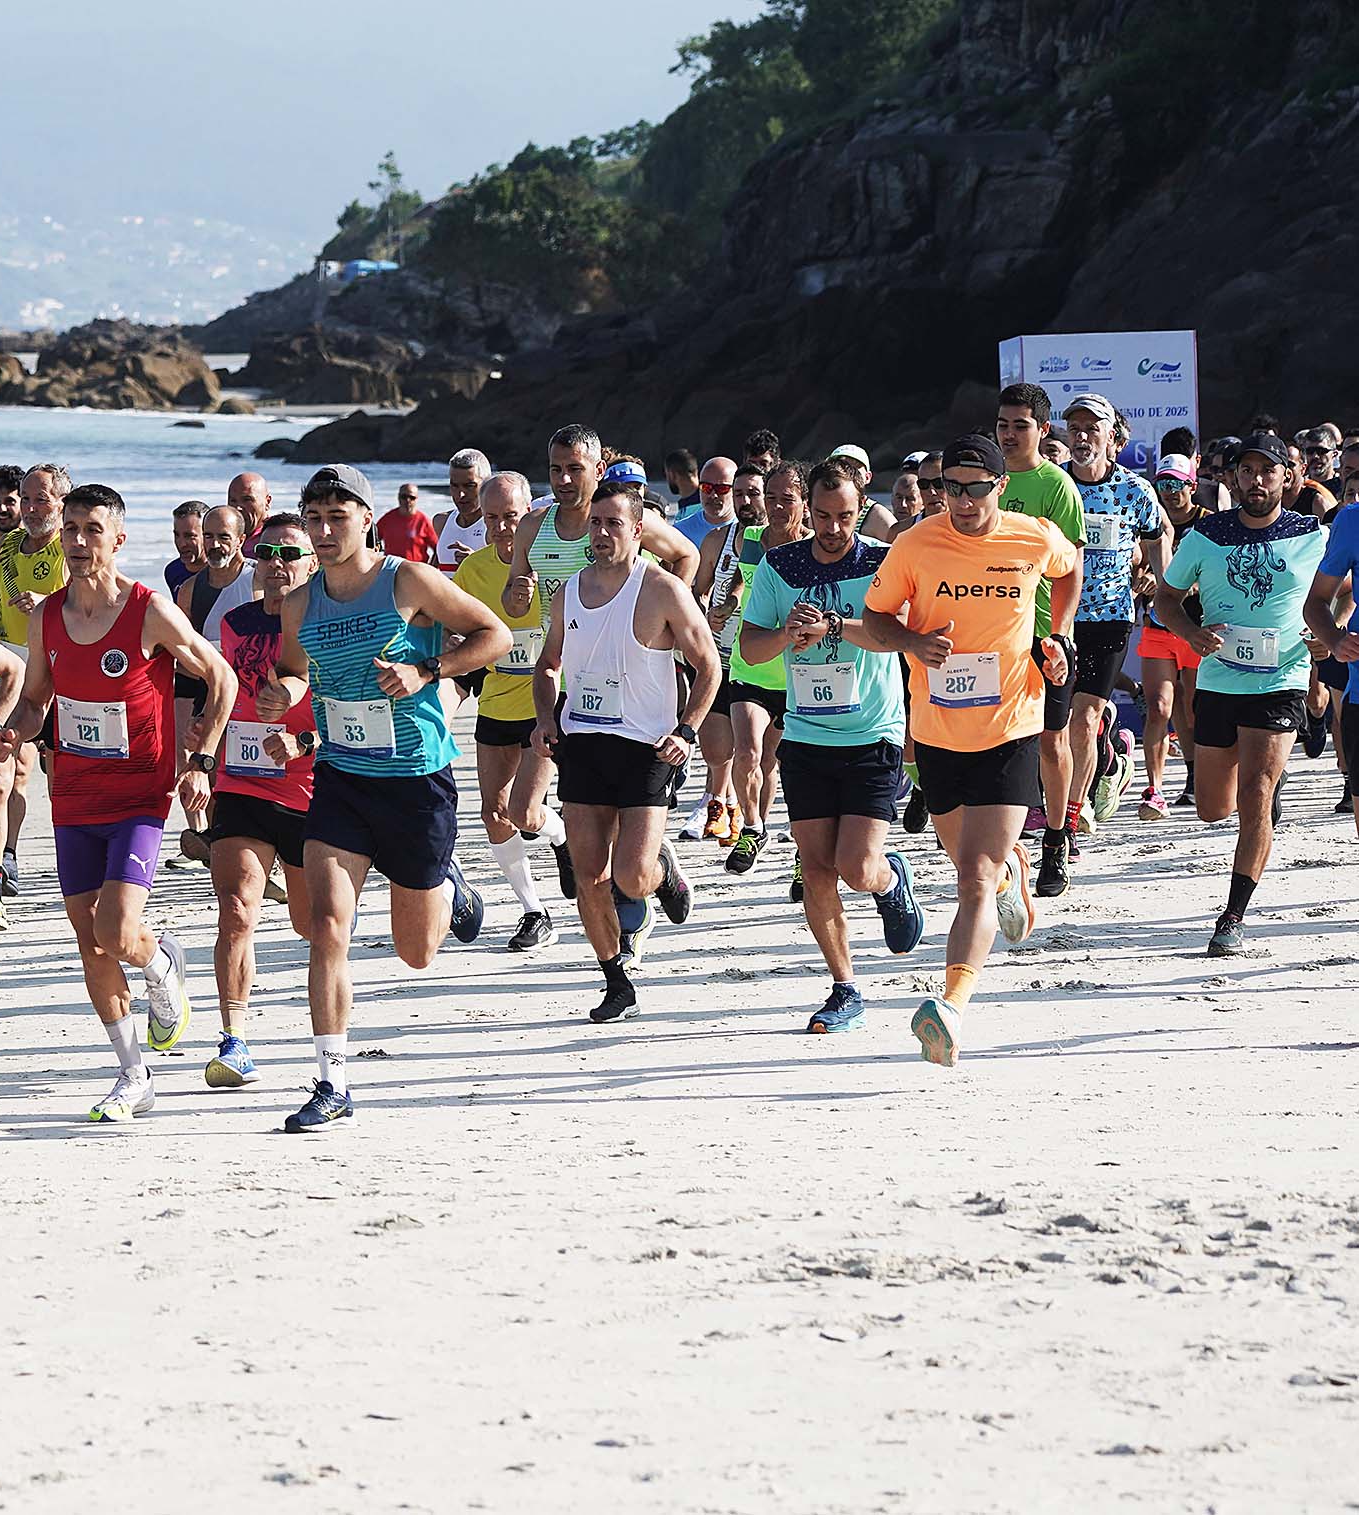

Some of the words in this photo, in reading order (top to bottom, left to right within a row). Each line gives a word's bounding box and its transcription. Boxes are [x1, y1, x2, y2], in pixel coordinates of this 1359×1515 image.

[1149, 407, 1163, 417] DE
[1165, 406, 1189, 417] 2025
[936, 581, 1021, 600] Apersa
[317, 614, 378, 641] SPIKES
[509, 649, 528, 663] 114
[1236, 646, 1254, 660] 65
[945, 676, 977, 693] 287
[813, 685, 833, 702] 66
[582, 694, 603, 711] 187
[77, 724, 100, 742] 121
[344, 725, 366, 742] 33
[241, 744, 260, 761] 80
